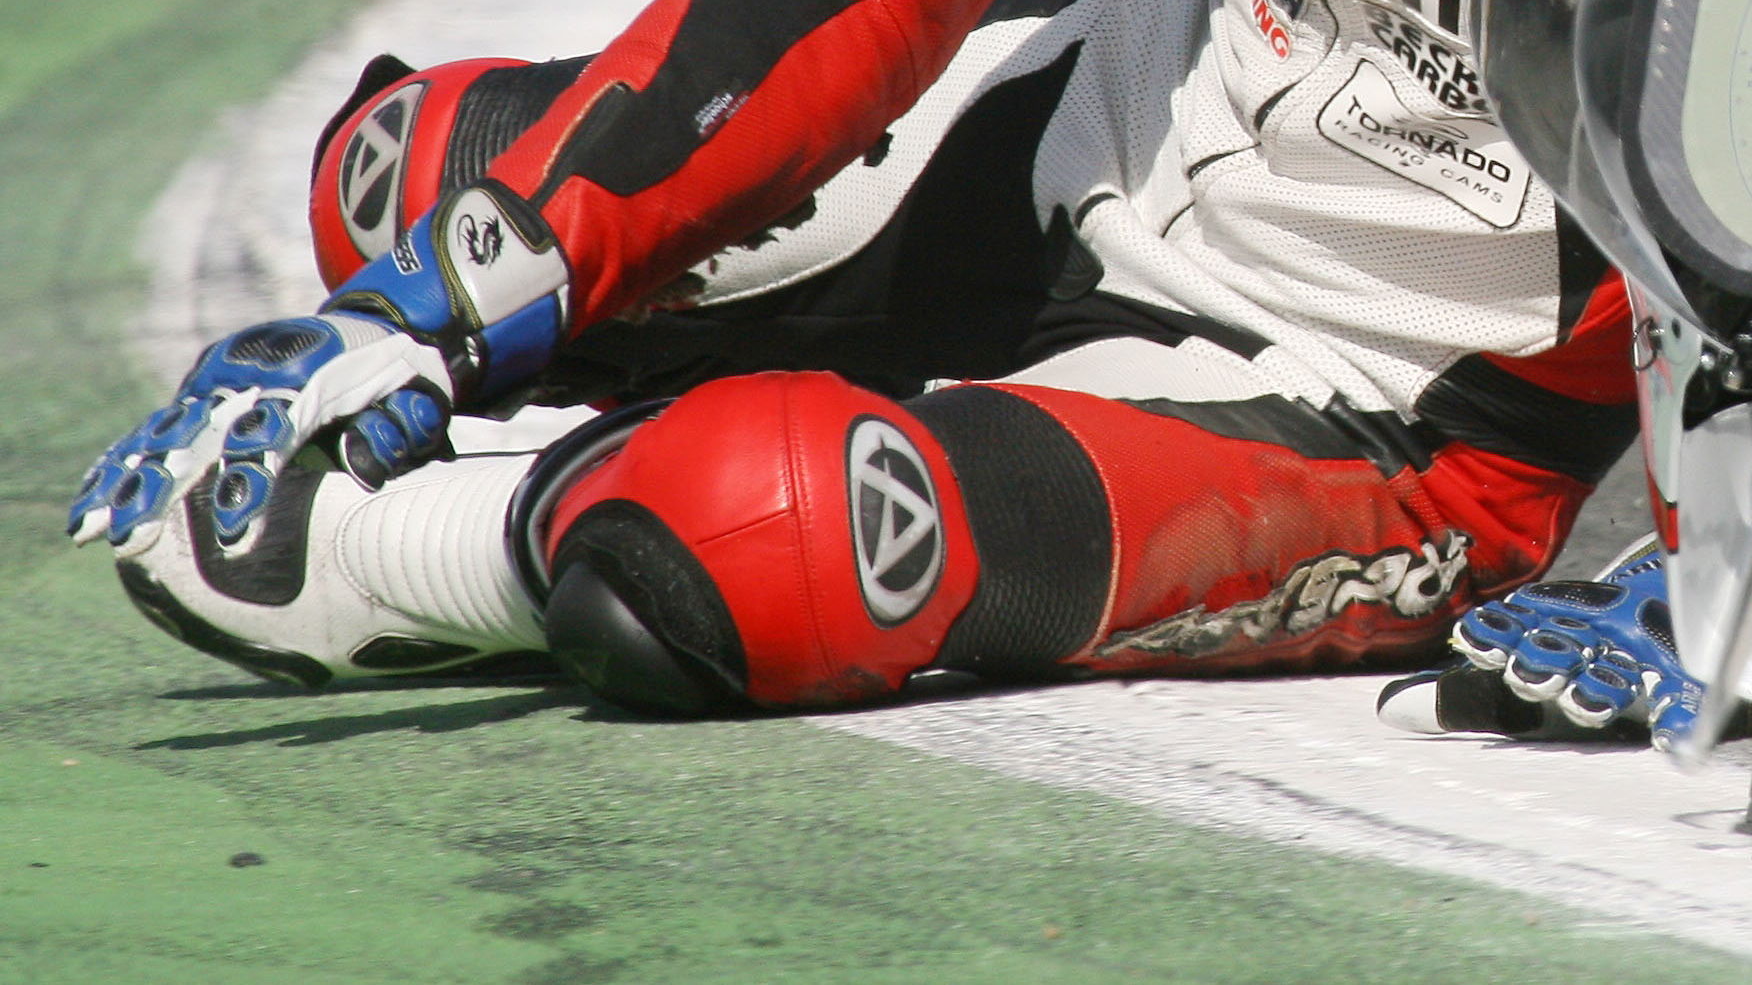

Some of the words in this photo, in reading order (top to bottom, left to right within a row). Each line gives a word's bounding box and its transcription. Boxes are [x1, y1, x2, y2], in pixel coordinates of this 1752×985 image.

[1335, 119, 1425, 166] RACING
[1440, 168, 1504, 204] CAMS
[1347, 94, 1511, 183] TORNADO
